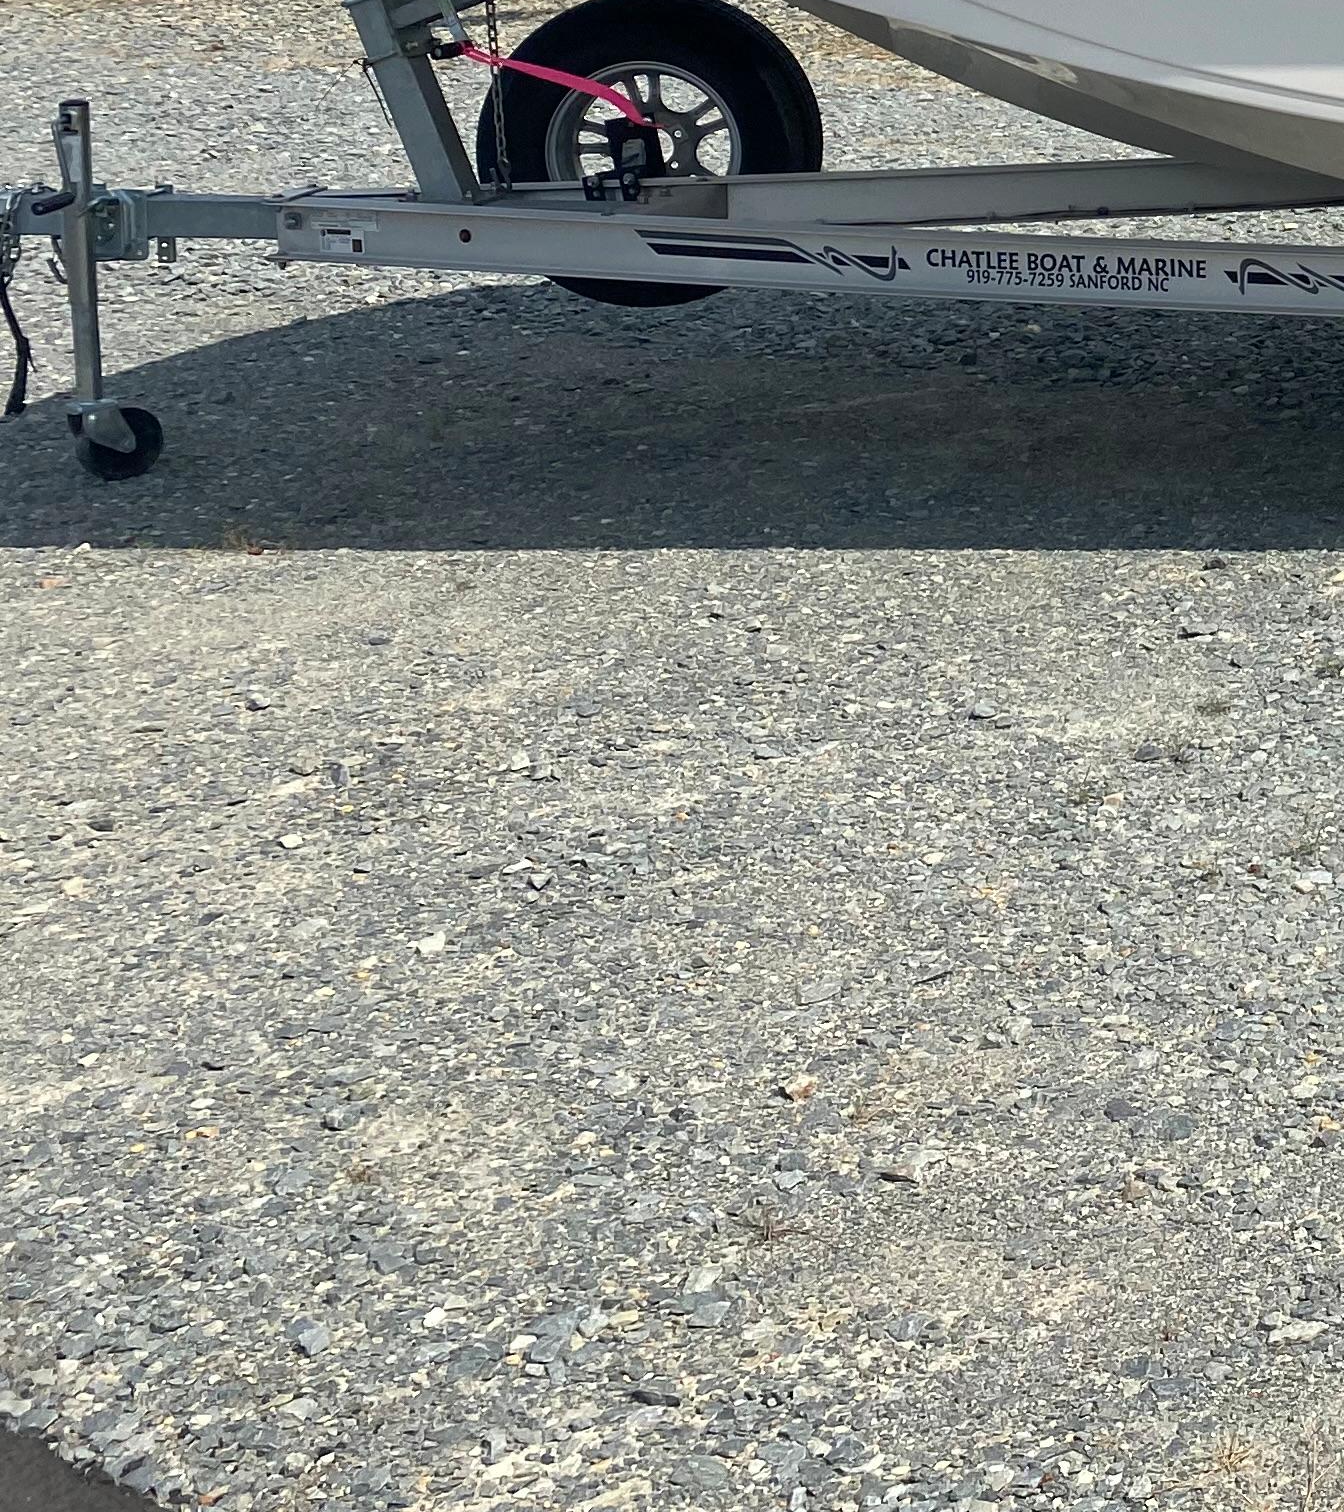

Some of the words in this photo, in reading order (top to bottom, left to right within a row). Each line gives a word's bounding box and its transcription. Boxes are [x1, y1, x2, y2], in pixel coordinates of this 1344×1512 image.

[926, 249, 1019, 271] CHATLEE
[1027, 253, 1086, 274] BOAT
[1093, 256, 1110, 275] &
[1116, 257, 1207, 279] MARINE
[966, 269, 1065, 288] 919-775-7259
[1069, 273, 1143, 292] SANFORD
[1148, 277, 1170, 293] NC
